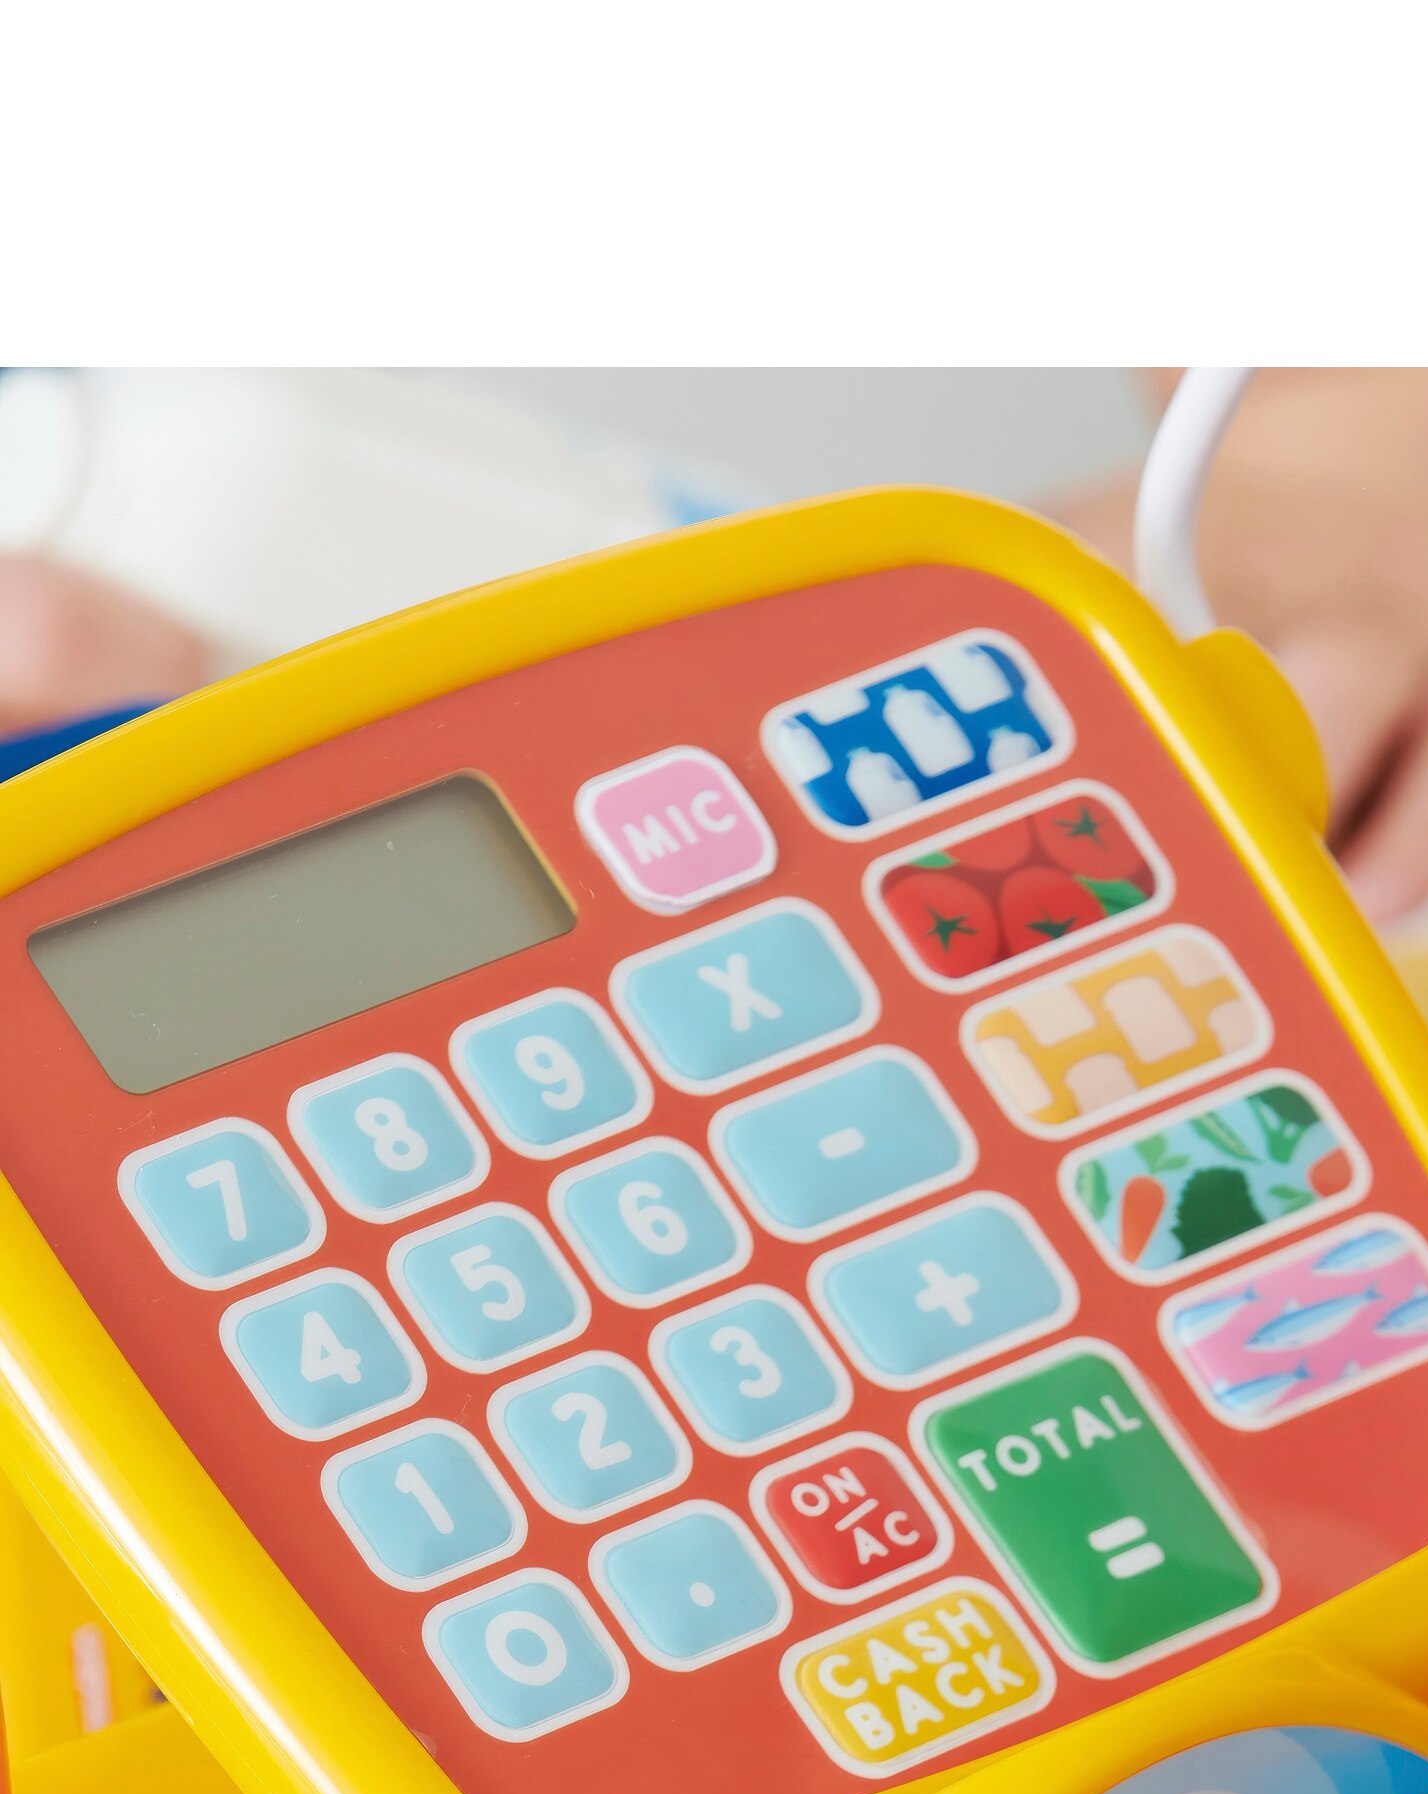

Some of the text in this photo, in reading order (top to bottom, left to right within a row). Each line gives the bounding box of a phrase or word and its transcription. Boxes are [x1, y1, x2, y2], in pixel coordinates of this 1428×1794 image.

[622, 790, 737, 865] MIC
[697, 953, 783, 1032] X
[514, 1034, 586, 1112] 9
[354, 1096, 429, 1171] 8
[186, 1160, 248, 1242] 7
[617, 1180, 689, 1256] 6
[450, 1243, 527, 1322] 5
[300, 1310, 363, 1385] 4
[709, 1325, 782, 1399] 3
[551, 1392, 633, 1471] 2
[957, 1393, 1142, 1492] TOTAL
[393, 1461, 455, 1535] 1
[790, 1465, 867, 1517] ON
[852, 1510, 921, 1566] AC
[816, 1598, 994, 1700] CASH
[843, 1644, 1026, 1751] BACK
